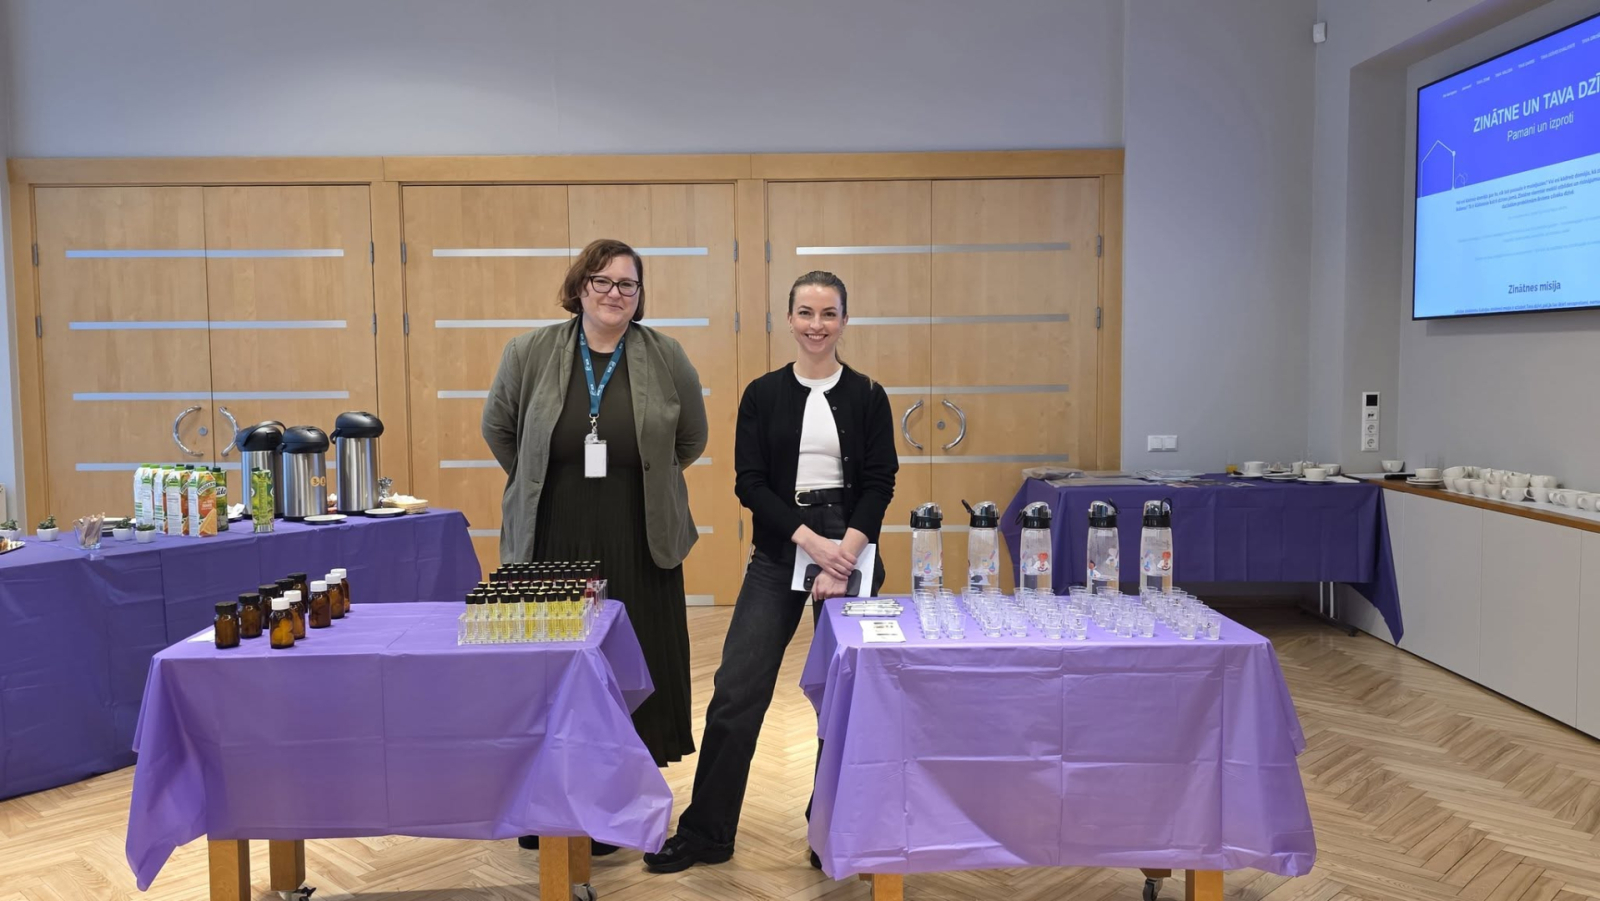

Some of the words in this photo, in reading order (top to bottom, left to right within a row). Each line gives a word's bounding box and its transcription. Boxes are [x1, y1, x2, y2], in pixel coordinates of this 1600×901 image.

[1473, 103, 1520, 133] ZINĀTNE
[1522, 96, 1540, 116] UN
[1543, 85, 1575, 109] TAVA
[1507, 123, 1536, 142] Pamani
[1537, 121, 1548, 133] un
[1549, 111, 1574, 130] izproti
[1508, 283, 1538, 295] Zinātnes
[1539, 281, 1561, 293] misija
